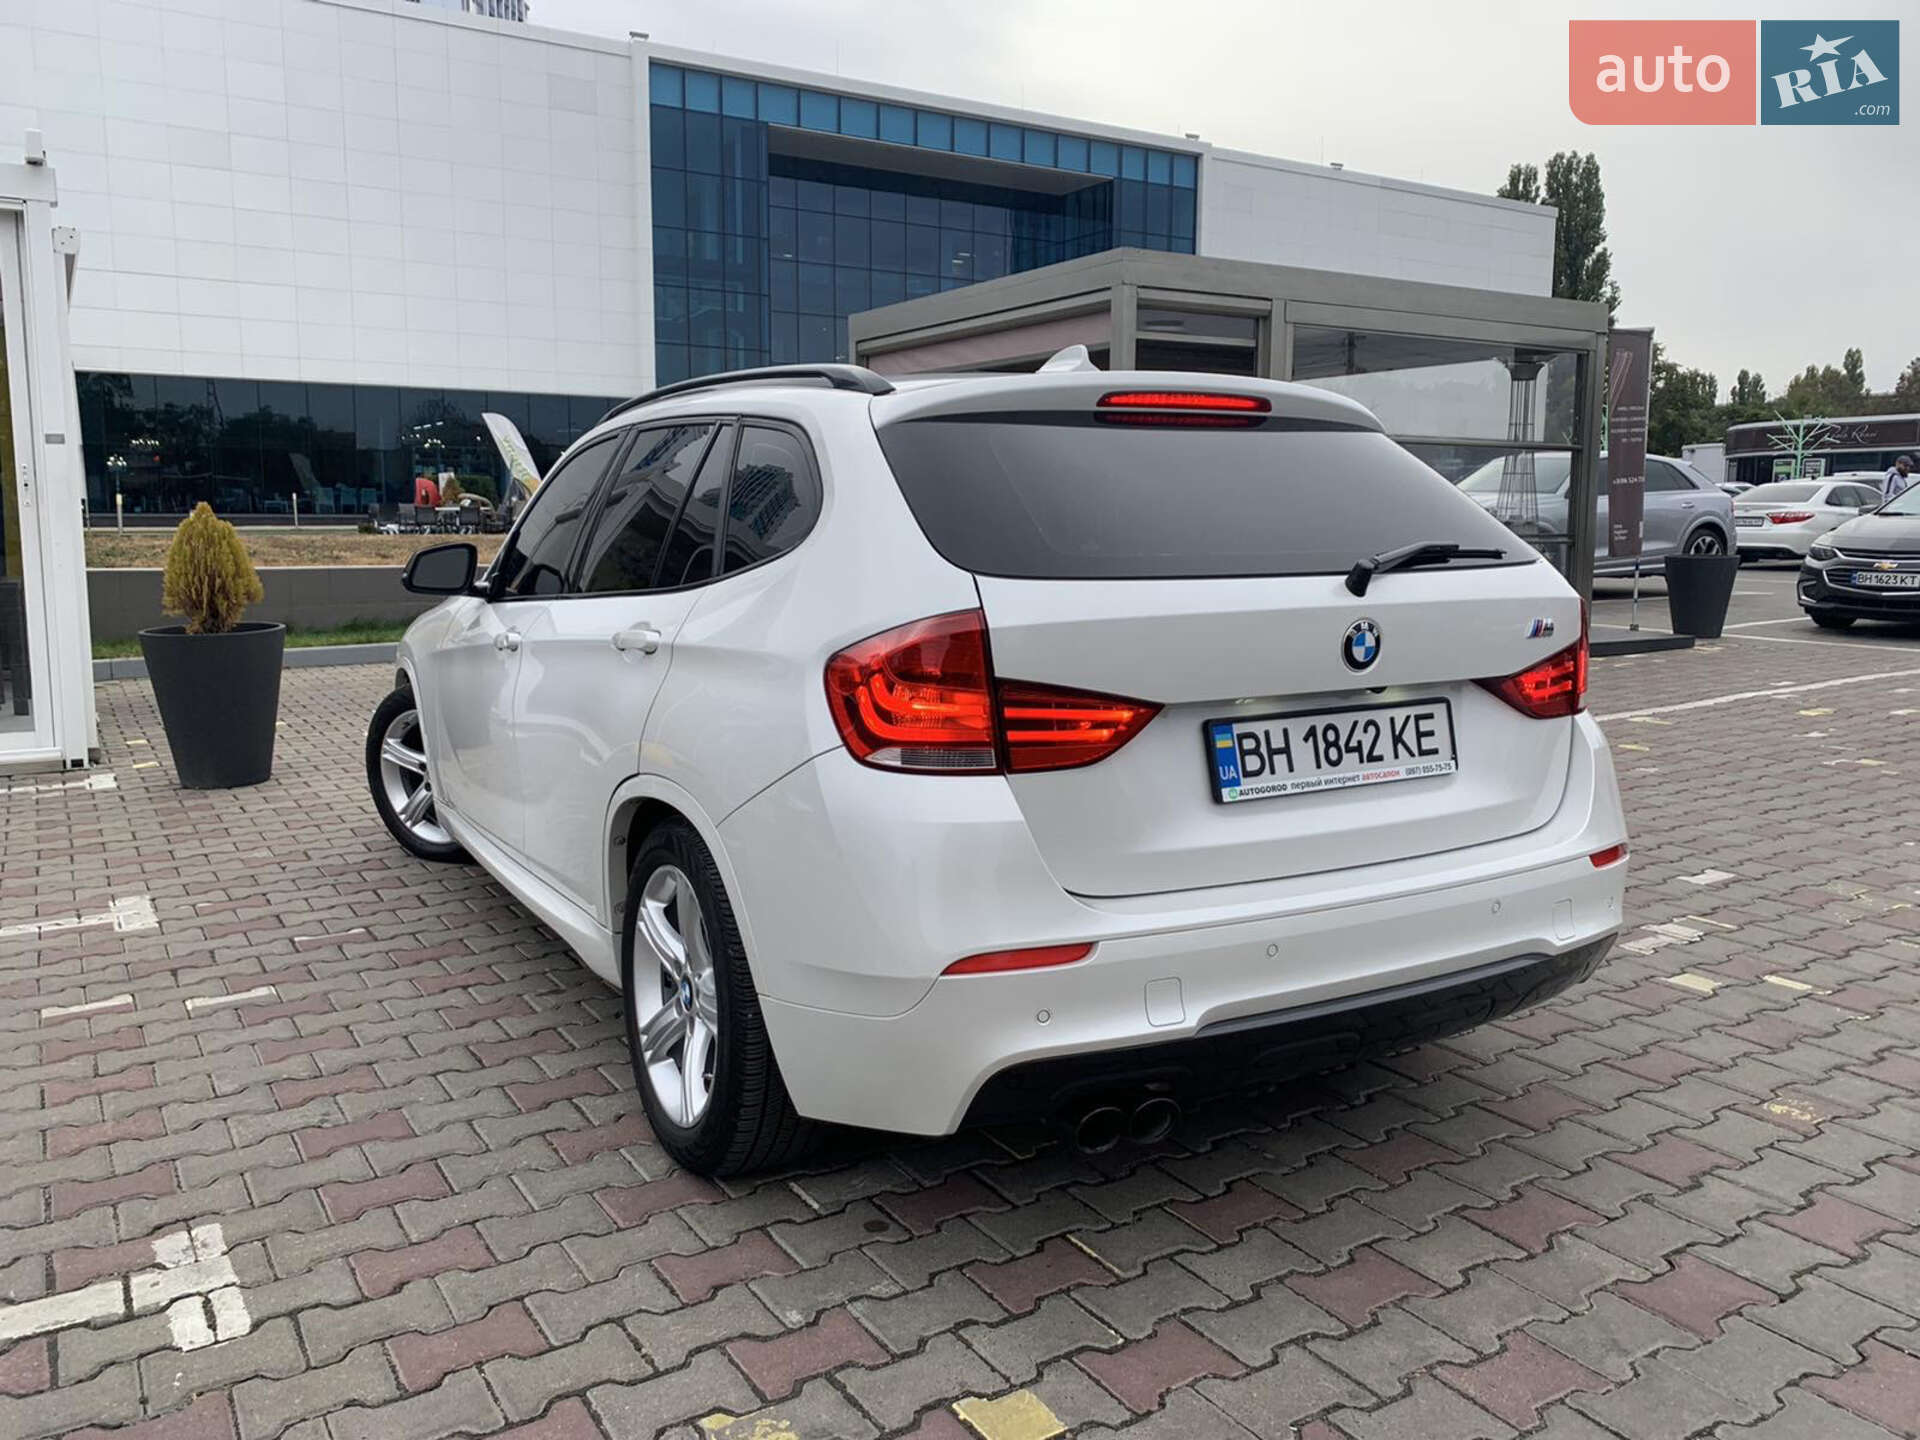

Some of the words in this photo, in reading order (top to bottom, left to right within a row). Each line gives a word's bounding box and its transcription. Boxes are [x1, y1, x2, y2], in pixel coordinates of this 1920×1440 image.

[1857, 573, 1873, 584] BH
[1874, 574, 1898, 585] 1623
[1900, 575, 1917, 585] KT
[1236, 727, 1295, 778] BH
[1303, 719, 1384, 769] 1842
[1390, 712, 1440, 759] KE
[1220, 765, 1238, 781] UA
[1238, 783, 1288, 798] AUTOGOROD
[1323, 774, 1361, 789] интернет
